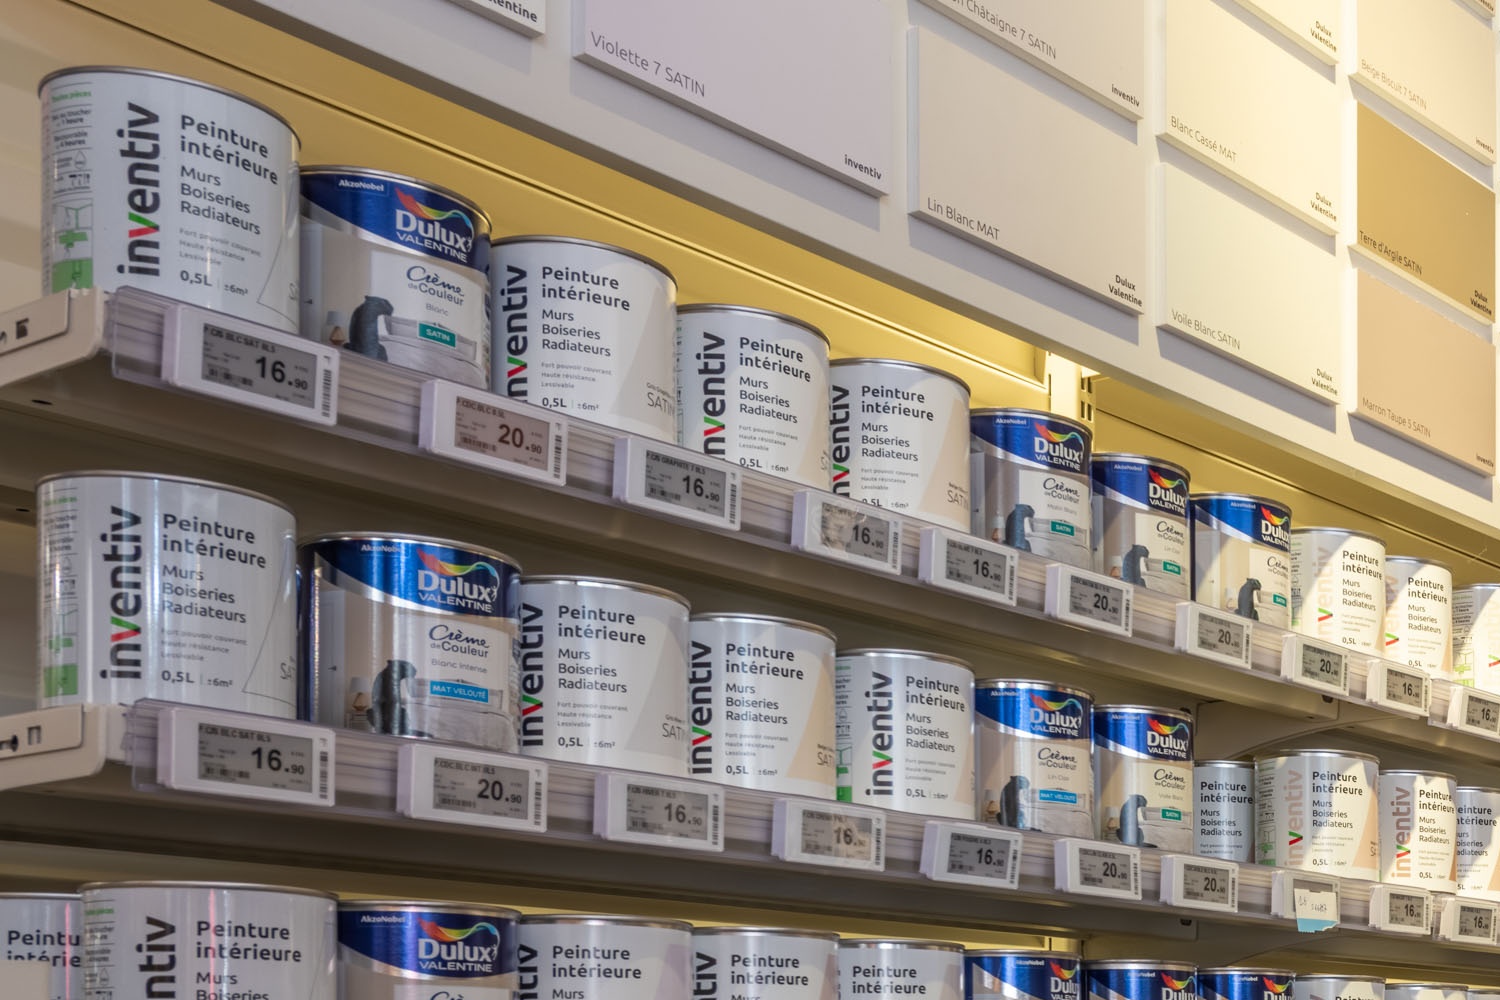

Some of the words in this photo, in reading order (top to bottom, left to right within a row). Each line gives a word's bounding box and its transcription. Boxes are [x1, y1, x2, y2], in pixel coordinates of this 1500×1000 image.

[1020, 28, 1027, 41] 7
[1028, 33, 1057, 60] SATIN
[591, 31, 649, 72] Violette
[654, 60, 662, 76] 7
[666, 67, 706, 99] SATIN
[1111, 84, 1140, 108] inventiv
[180, 114, 269, 159] Peinture
[1171, 115, 1194, 139] Blanc
[1195, 128, 1217, 152] Cassé
[1219, 144, 1237, 163] MAT
[180, 135, 278, 185] intérieure
[844, 154, 882, 181] inventiv
[116, 101, 160, 277] inventiv
[180, 165, 222, 187] Murs
[180, 183, 251, 215] Boiseries
[180, 201, 262, 236] Radiateurs
[395, 208, 473, 253] Dulux
[927, 197, 943, 215] Lin
[946, 205, 975, 230] Blanc
[977, 219, 1000, 241] MAT
[396, 231, 468, 264] VALENTINE
[1359, 230, 1378, 250] Terre
[1403, 253, 1423, 276] SATIN
[180, 269, 213, 288] 0,5L
[406, 265, 466, 298] Crème
[1115, 275, 1136, 292] Dulux
[418, 282, 465, 307] Couleur
[1108, 285, 1143, 308] Valentine
[425, 329, 451, 343] SATIN
[1171, 309, 1193, 328] Voile
[1193, 318, 1216, 340] Blanc
[1217, 331, 1241, 351] SATIN
[255, 356, 309, 391] 16.90
[1362, 397, 1384, 419] Marron
[1384, 407, 1407, 430] Taupe
[1413, 420, 1431, 439] SATIN
[417, 569, 497, 603] Dulux
[417, 591, 493, 614] VALENTINE
[432, 685, 451, 696] MAT
[453, 686, 487, 701] VELOUTÉ
[864, 671, 894, 797] inventiv
[250, 746, 305, 776] 16.90
[476, 778, 523, 806] 20.90
[1312, 771, 1358, 784] Peinture
[1312, 782, 1363, 797] intérieure
[196, 920, 291, 941] Peinture
[196, 941, 302, 963] intérieure
[418, 937, 497, 962] Dulux
[196, 972, 238, 985] Murs
[418, 961, 493, 973] VALENTINE
